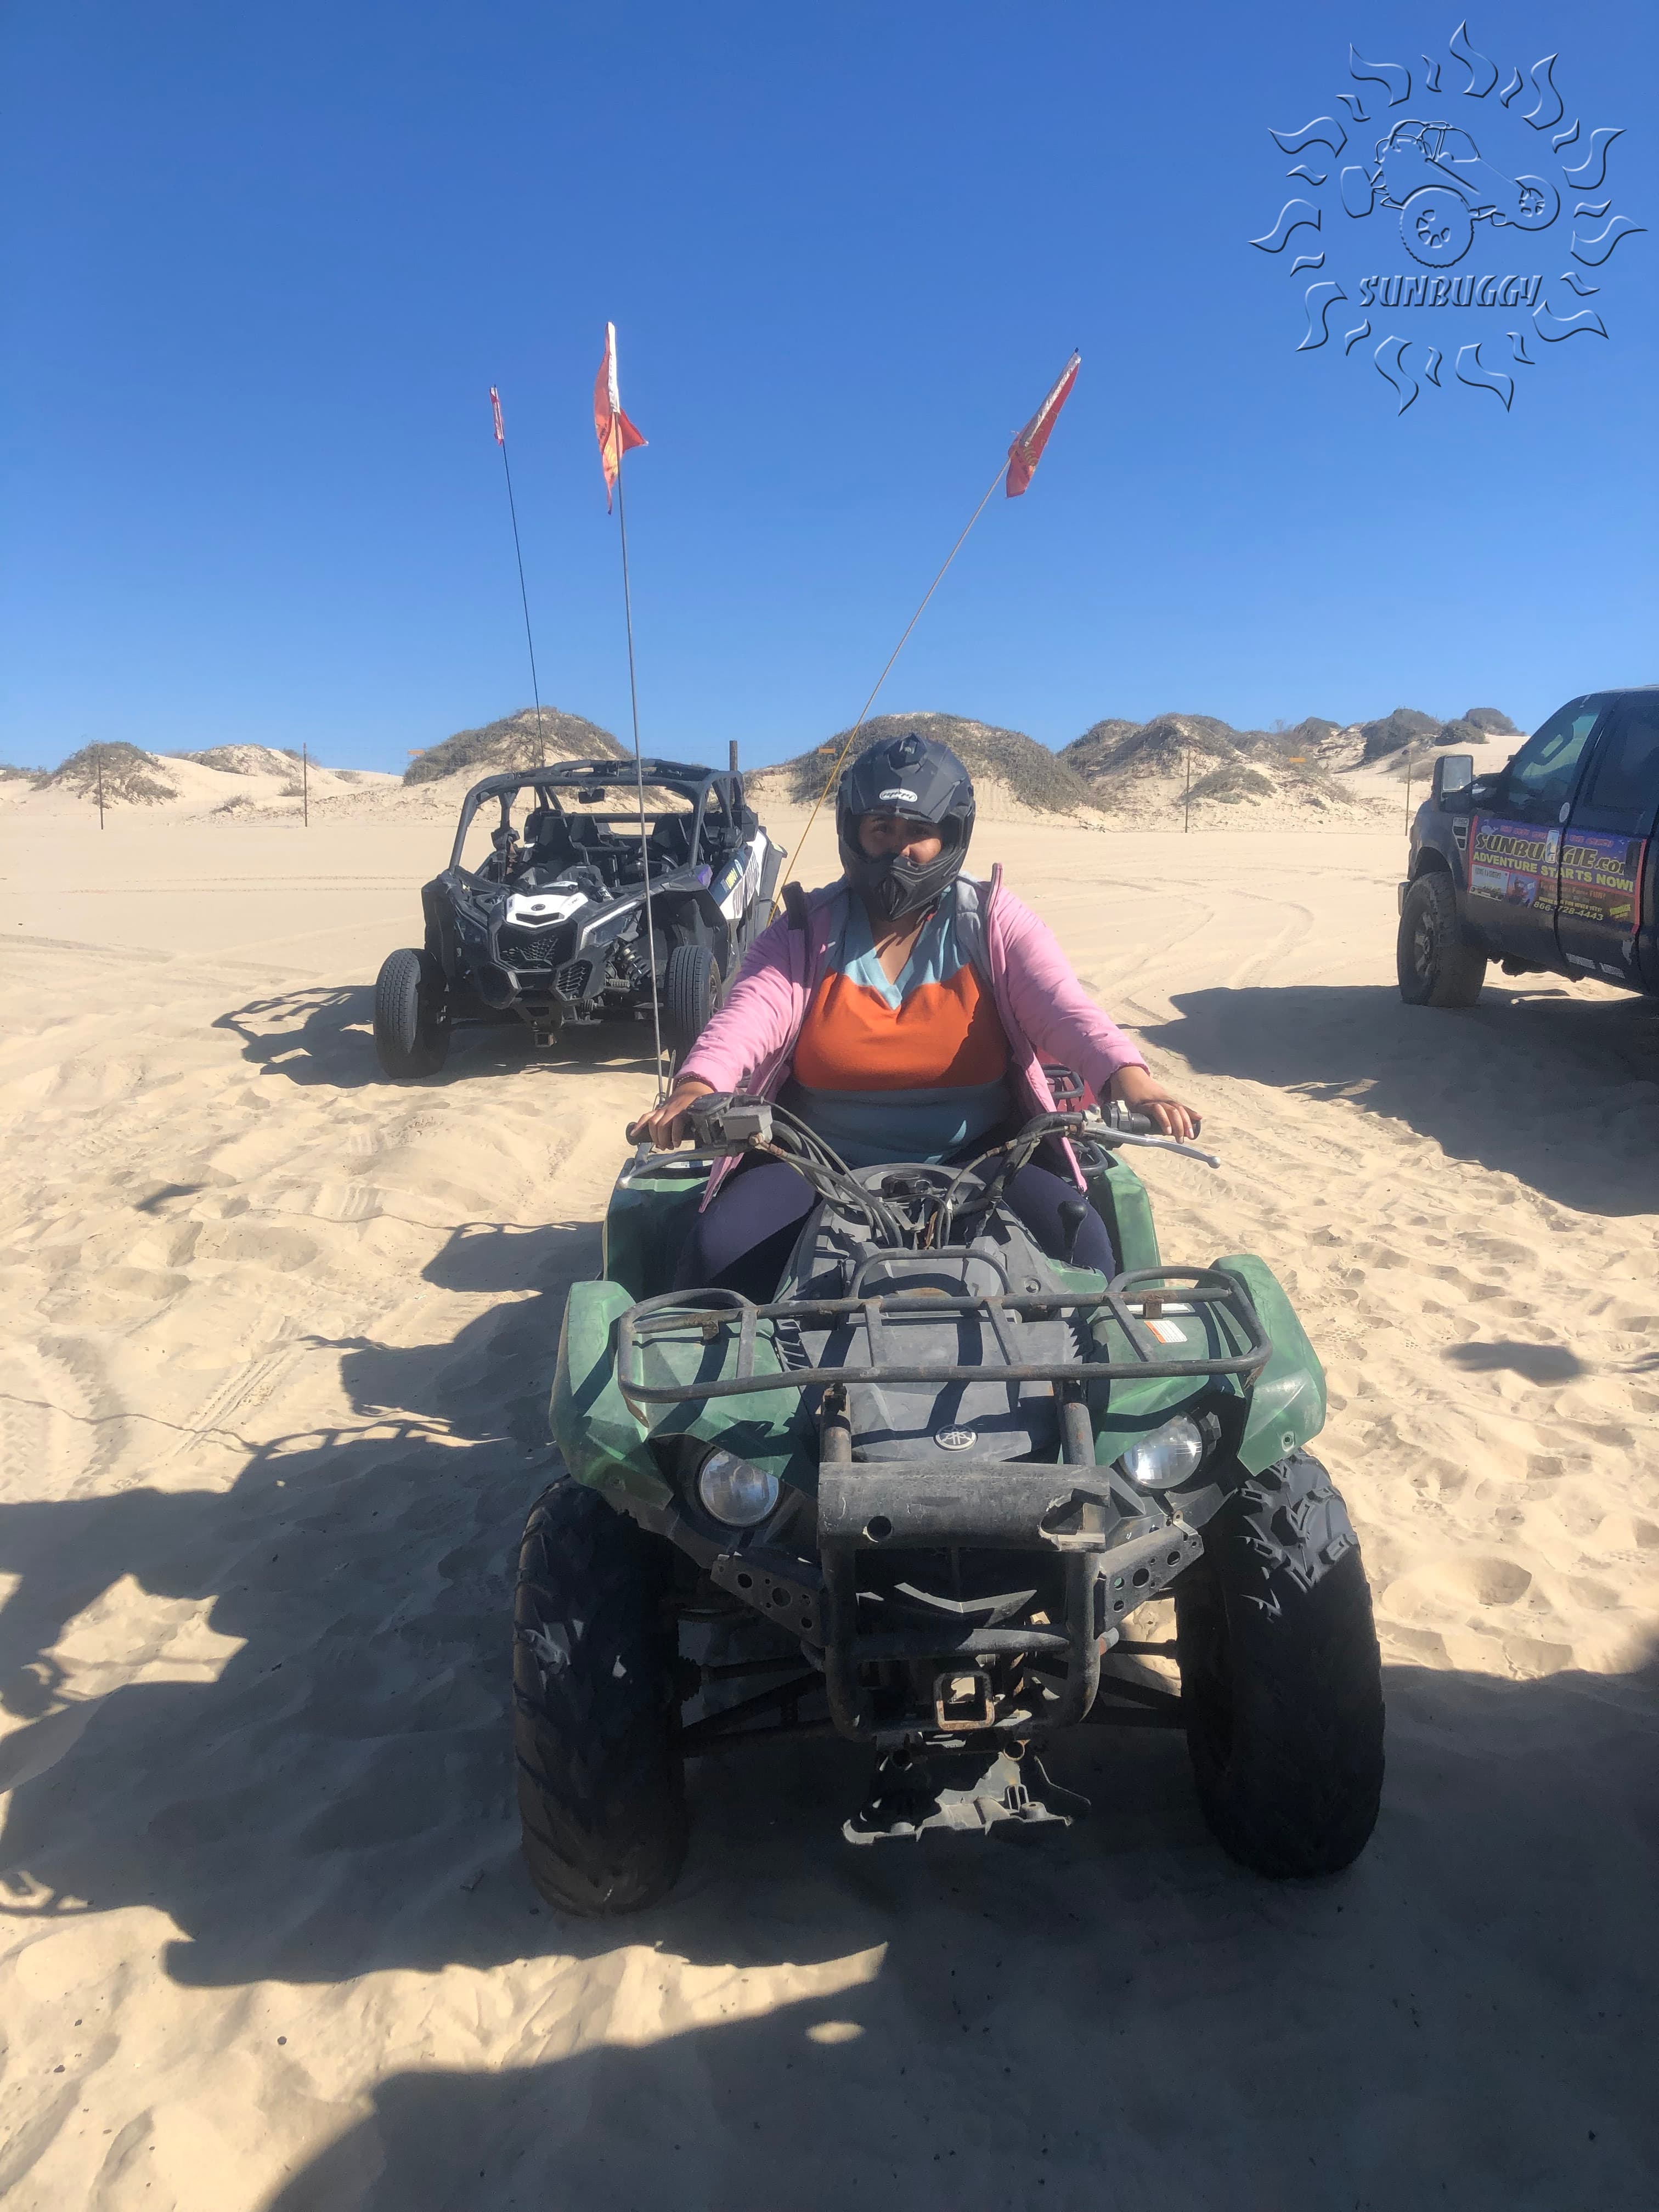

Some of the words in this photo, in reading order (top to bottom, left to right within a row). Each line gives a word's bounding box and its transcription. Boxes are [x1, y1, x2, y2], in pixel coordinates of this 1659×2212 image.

[1473, 851, 1537, 873] ADVENTURE
[1541, 865, 1592, 883] STARTS
[1596, 873, 1633, 892] NOW!
